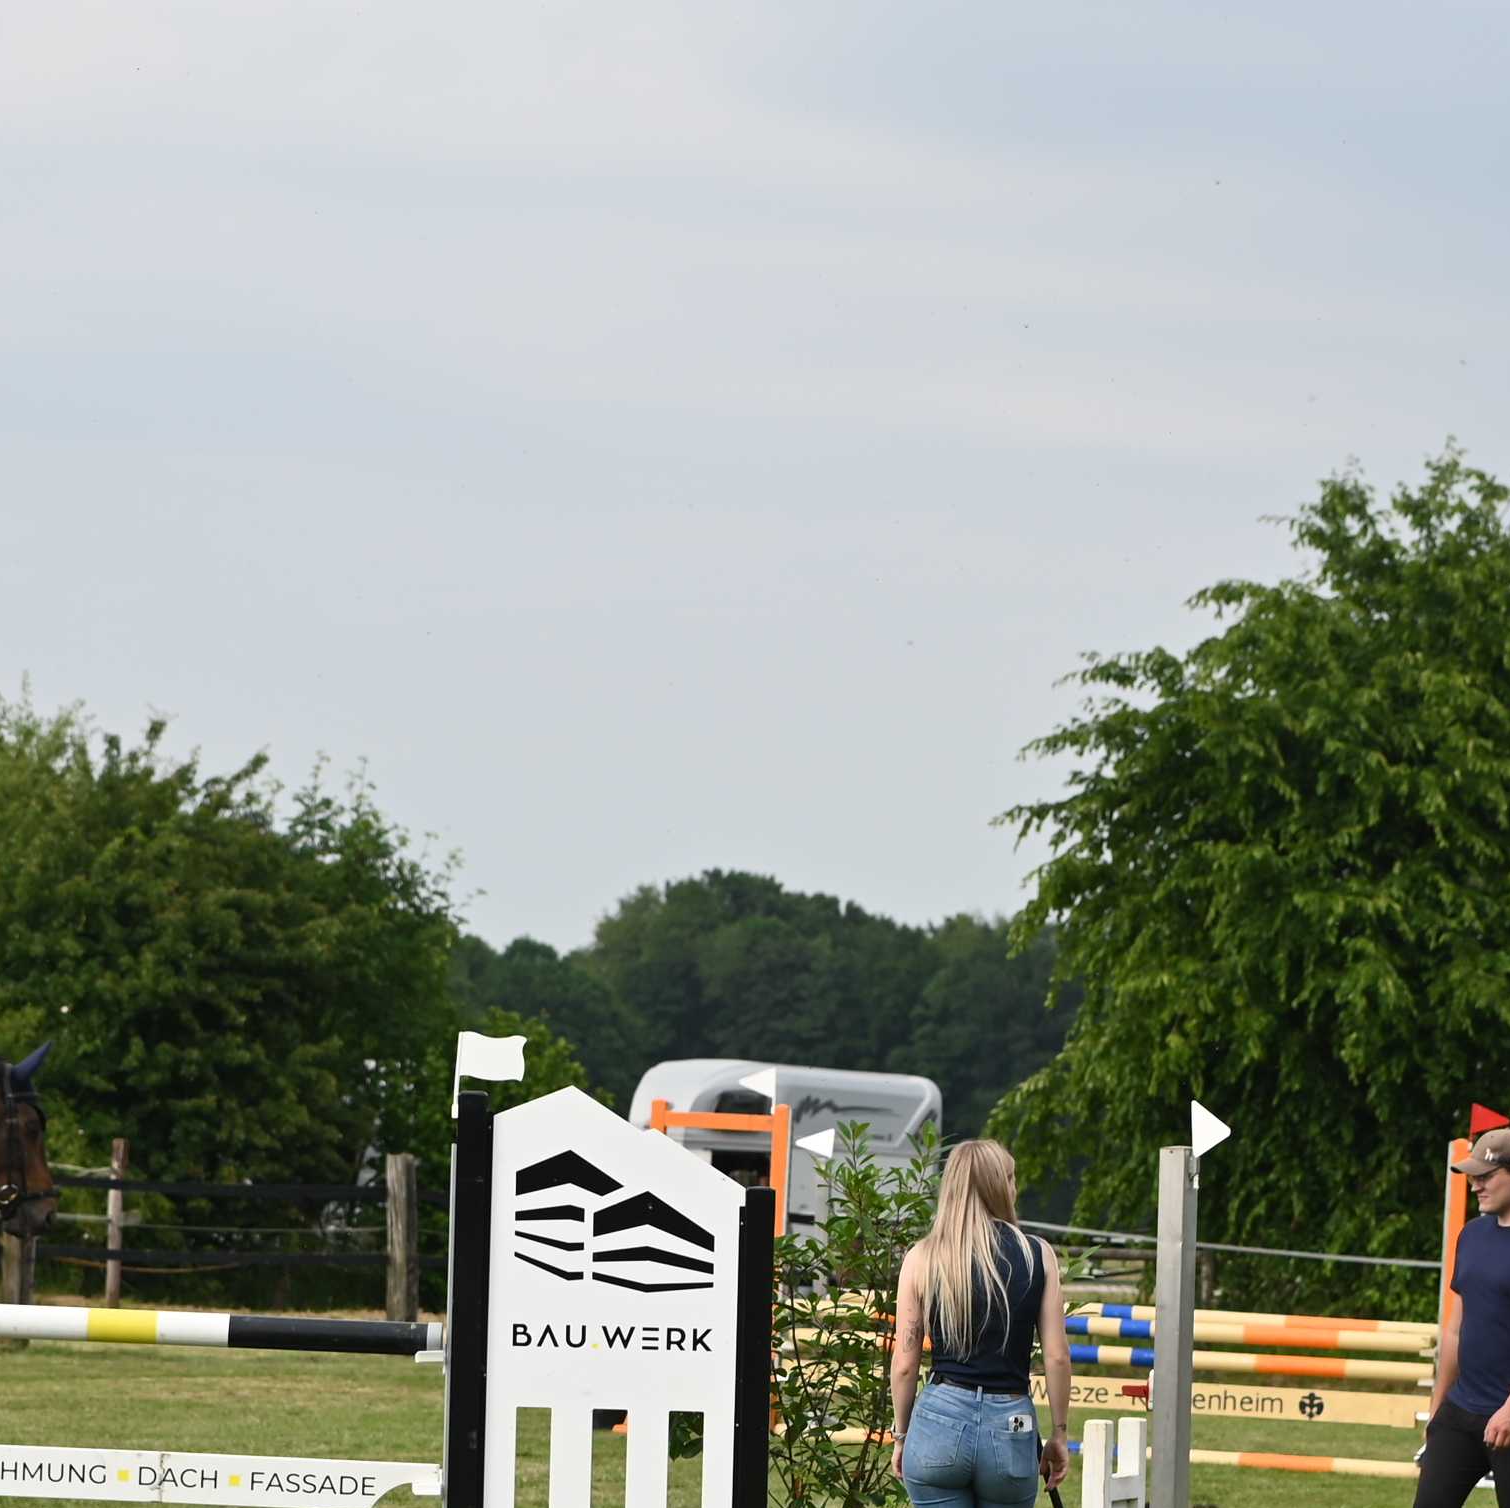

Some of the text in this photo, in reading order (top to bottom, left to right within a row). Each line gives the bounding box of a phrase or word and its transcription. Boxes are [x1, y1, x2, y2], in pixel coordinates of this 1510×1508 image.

[1028, 1380, 1108, 1404] Weze
[138, 1466, 219, 1489] DACH
[250, 1471, 377, 1497] FASSADE
